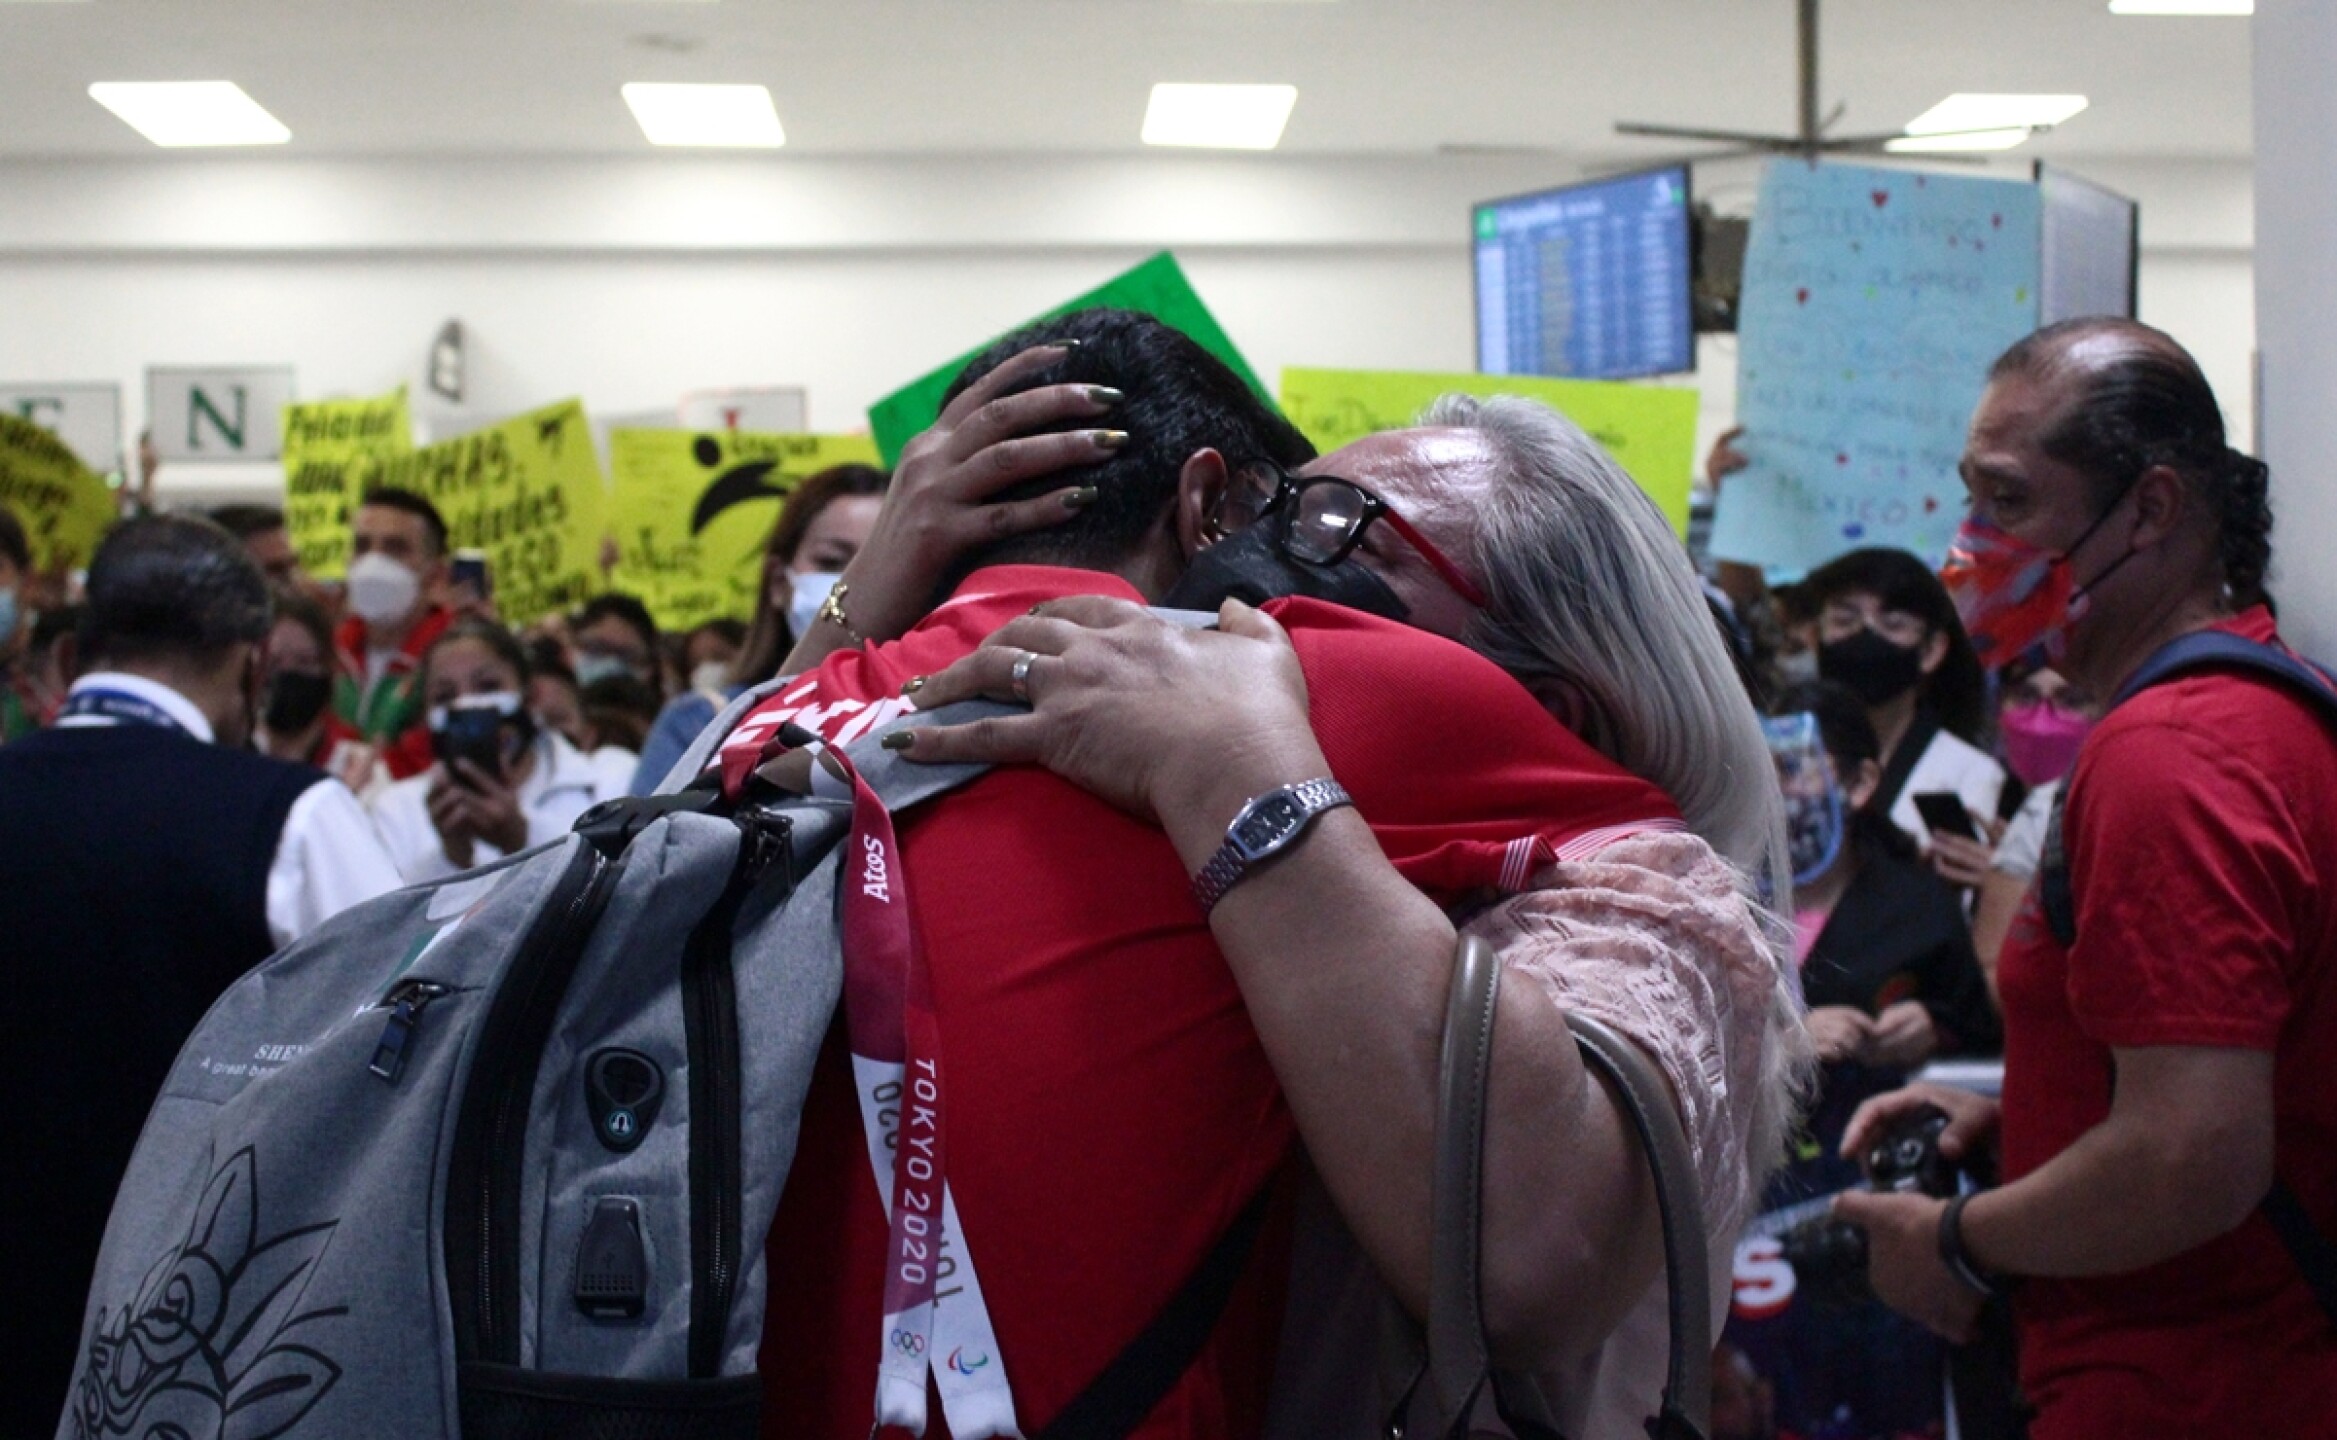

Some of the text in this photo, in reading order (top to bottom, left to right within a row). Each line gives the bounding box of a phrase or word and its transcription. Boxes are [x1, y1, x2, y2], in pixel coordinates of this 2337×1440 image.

[186, 383, 248, 451] N
[863, 833, 890, 904] Atos
[900, 1057, 938, 1286] TOKYO 2020
